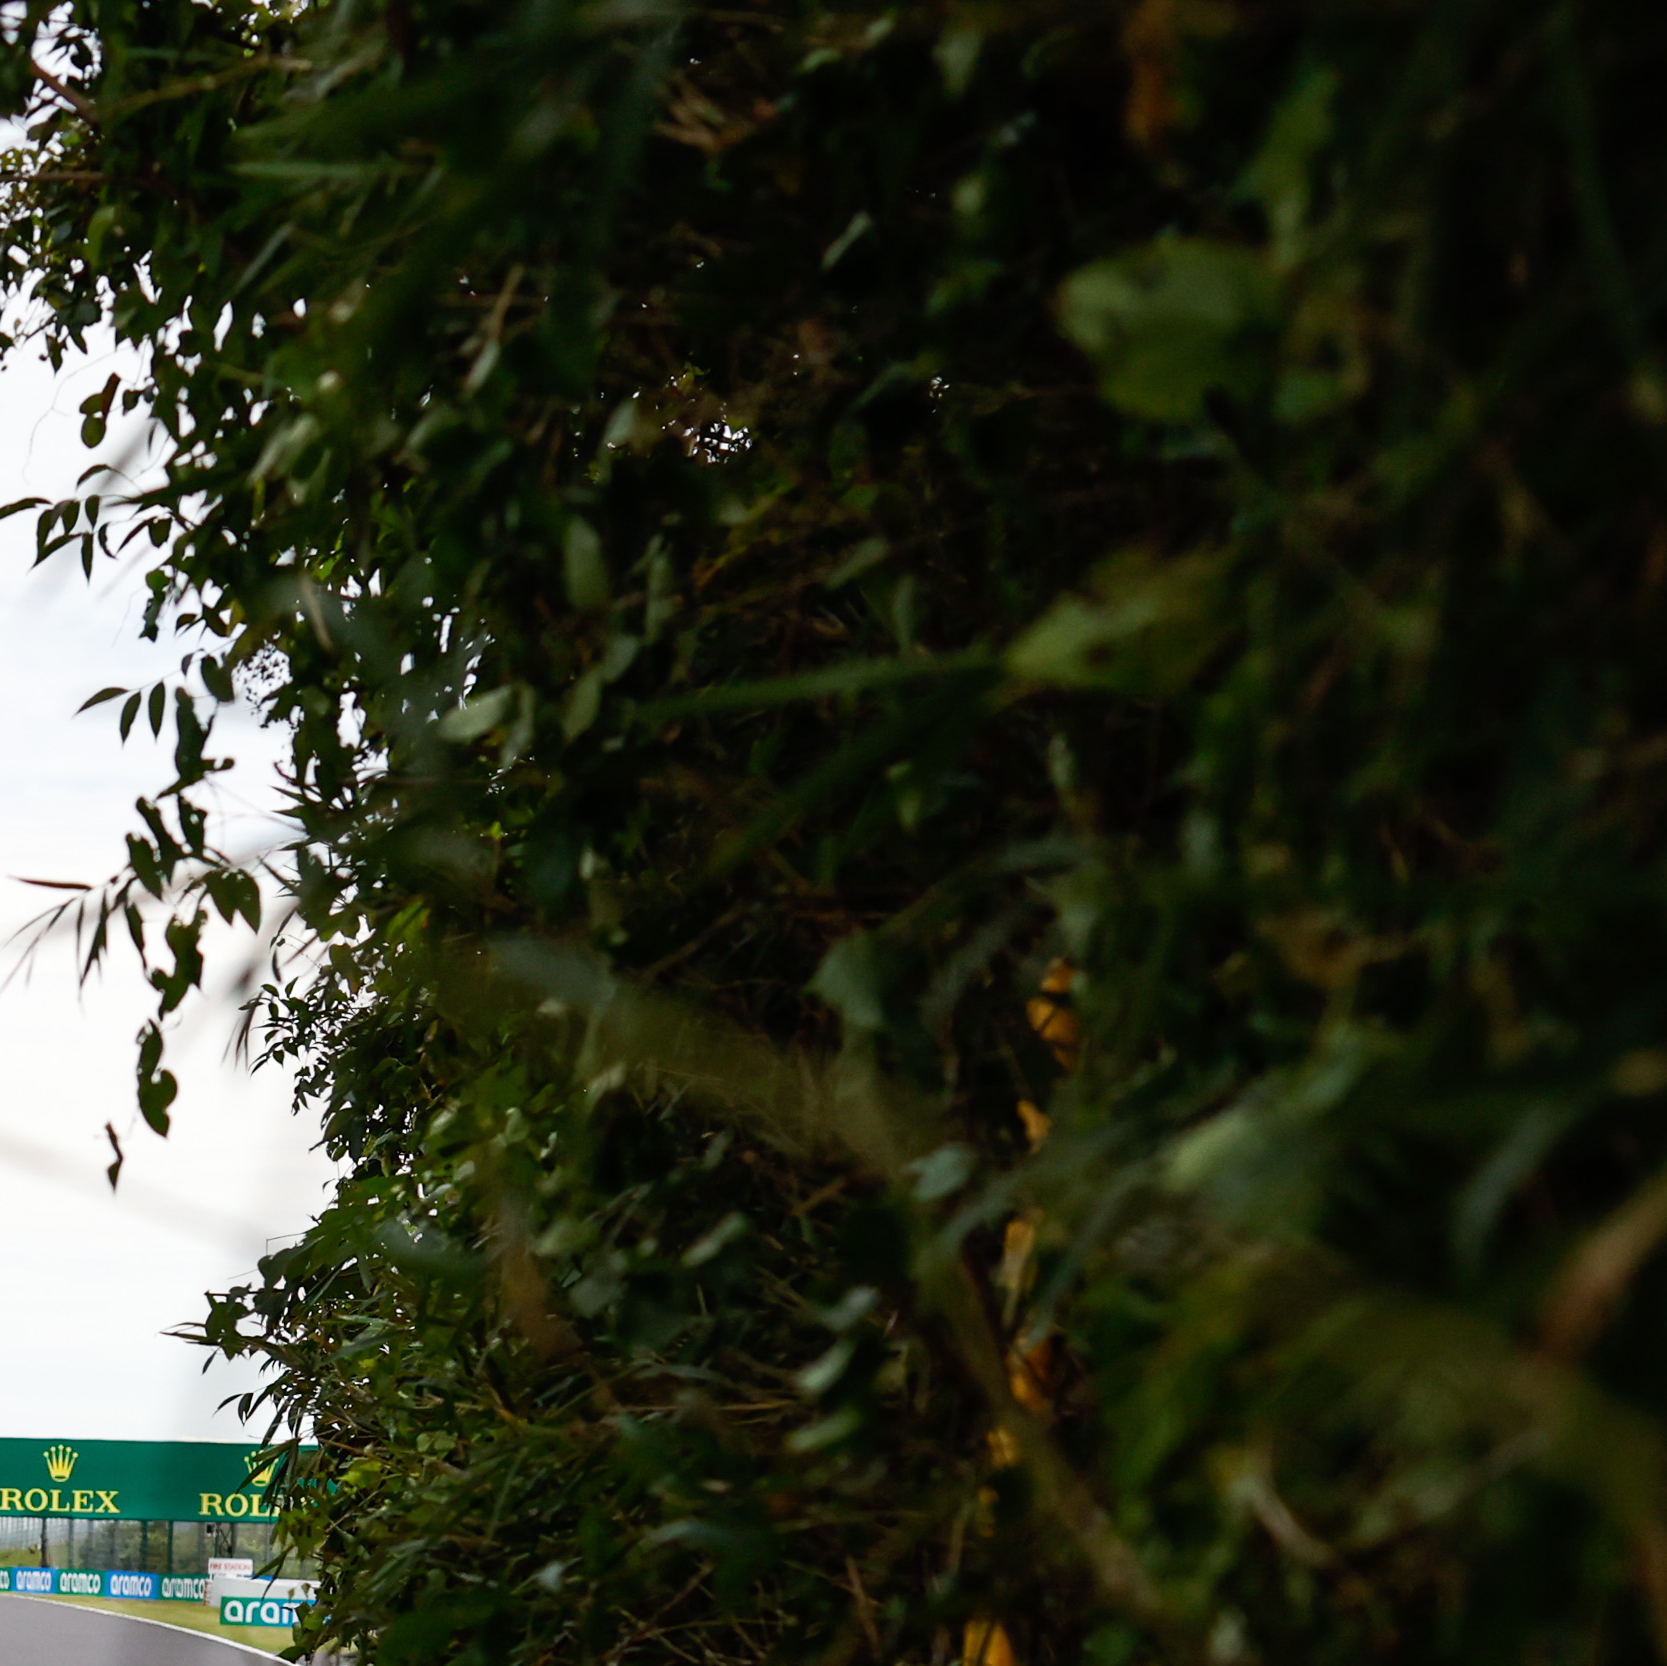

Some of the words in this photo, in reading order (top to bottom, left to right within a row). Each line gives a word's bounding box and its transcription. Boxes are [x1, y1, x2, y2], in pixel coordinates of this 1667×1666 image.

[0, 1488, 120, 1513] ROLEX
[199, 1493, 282, 1517] ROL
[16, 1570, 51, 1591] aramco
[59, 1573, 101, 1594] aramco
[110, 1574, 152, 1597] aramco
[162, 1577, 204, 1599] aramco
[224, 1600, 301, 1624] aram
